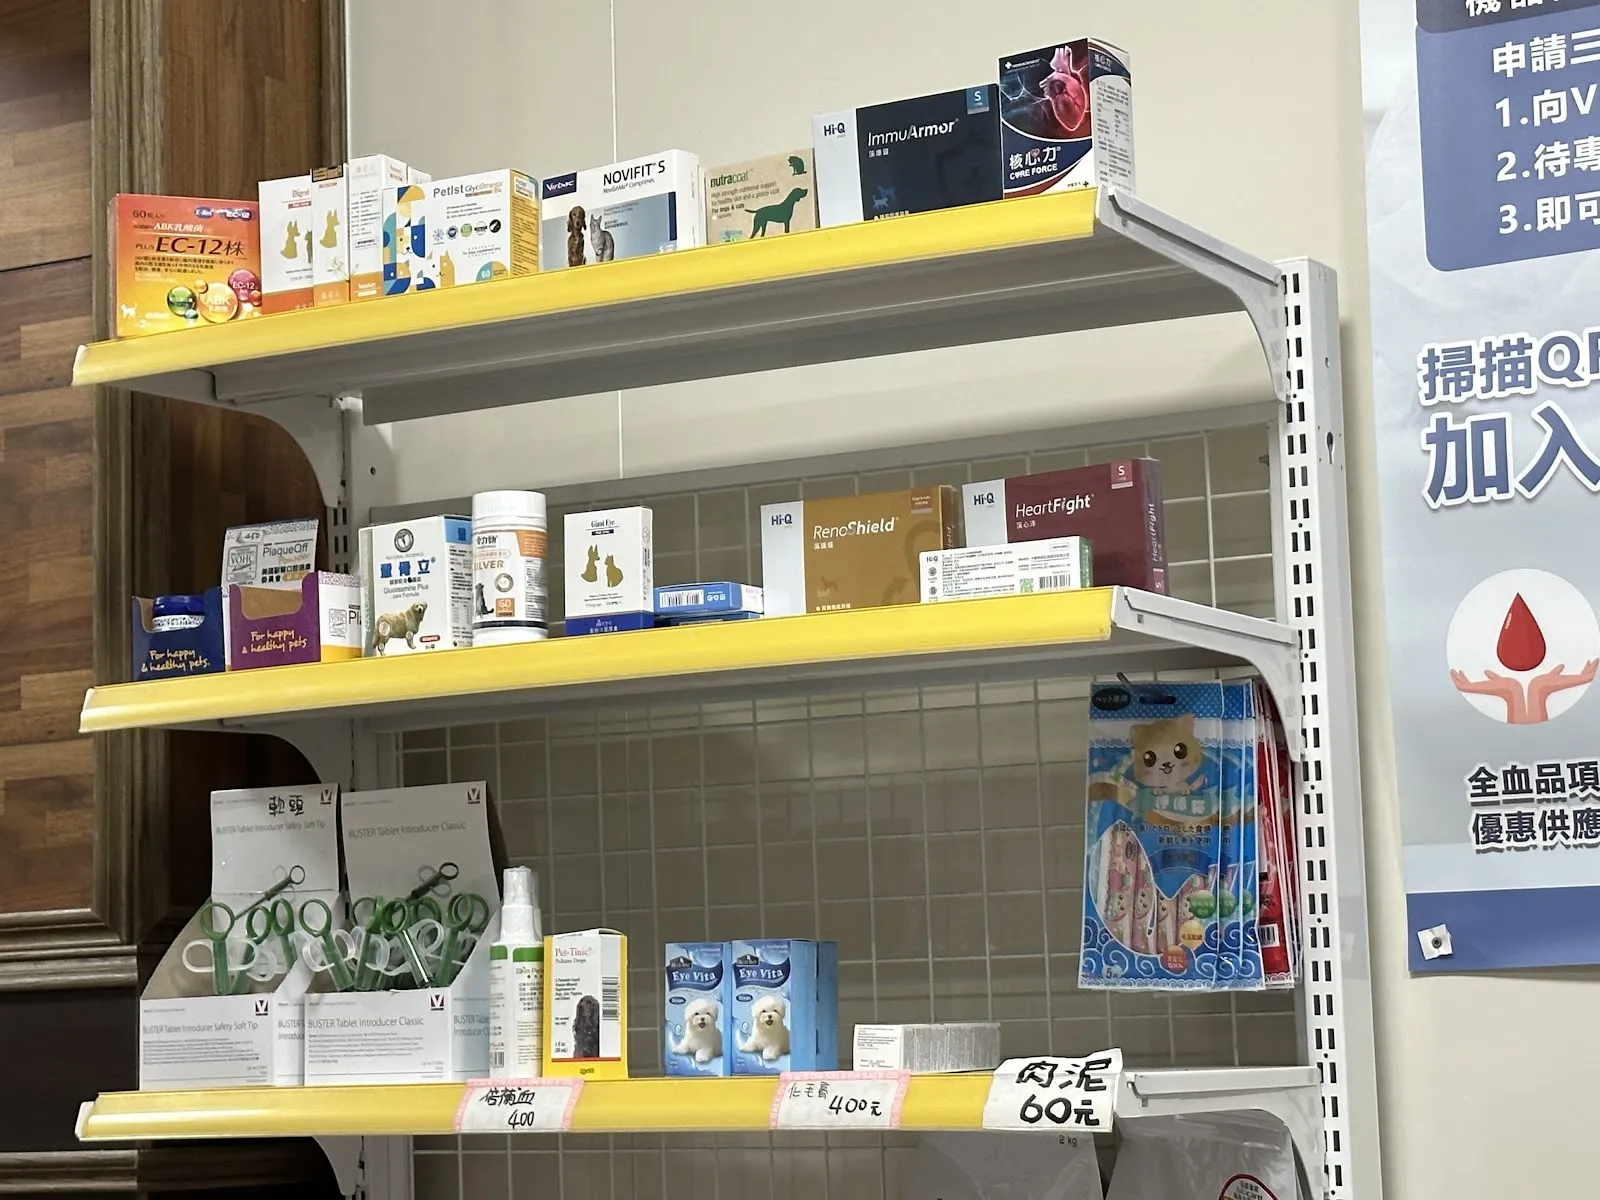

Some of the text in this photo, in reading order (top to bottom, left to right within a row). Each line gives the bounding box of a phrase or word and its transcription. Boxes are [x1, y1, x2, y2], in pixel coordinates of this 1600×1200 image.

[974, 90, 982, 102] S
[868, 120, 955, 146] ImmuArmor
[1009, 146, 1057, 169] 核心力
[1031, 163, 1058, 175] FORCE
[546, 180, 577, 191] Virbac
[1426, 405, 1600, 503] 加入
[1117, 465, 1124, 476] S
[1016, 494, 1091, 518] HeartFight
[813, 516, 895, 539] RenoShield
[262, 543, 309, 557] PlaqueOff
[250, 628, 295, 642] For happy
[251, 639, 285, 653] healthy
[150, 648, 196, 661] For happy
[149, 661, 186, 673] healthy
[1468, 761, 1600, 798] 全血品項
[348, 821, 467, 839] BUSTER Tablet Introducer Classic
[1472, 808, 1600, 845] 優惠供應
[672, 970, 716, 982] Eye Vita
[739, 968, 783, 979] Eye Vita
[182, 1022, 214, 1033] Introducer
[234, 1021, 247, 1031] Soft
[248, 1021, 259, 1032] Tip
[308, 1015, 424, 1028] BUSTER Tablet Introducer Classic
[1016, 1058, 1112, 1092] 肉泥
[828, 1095, 882, 1117] 400元
[1019, 1094, 1100, 1126] 60元
[507, 1109, 535, 1130] 400
[1059, 1135, 1078, 1147] 2 kg
